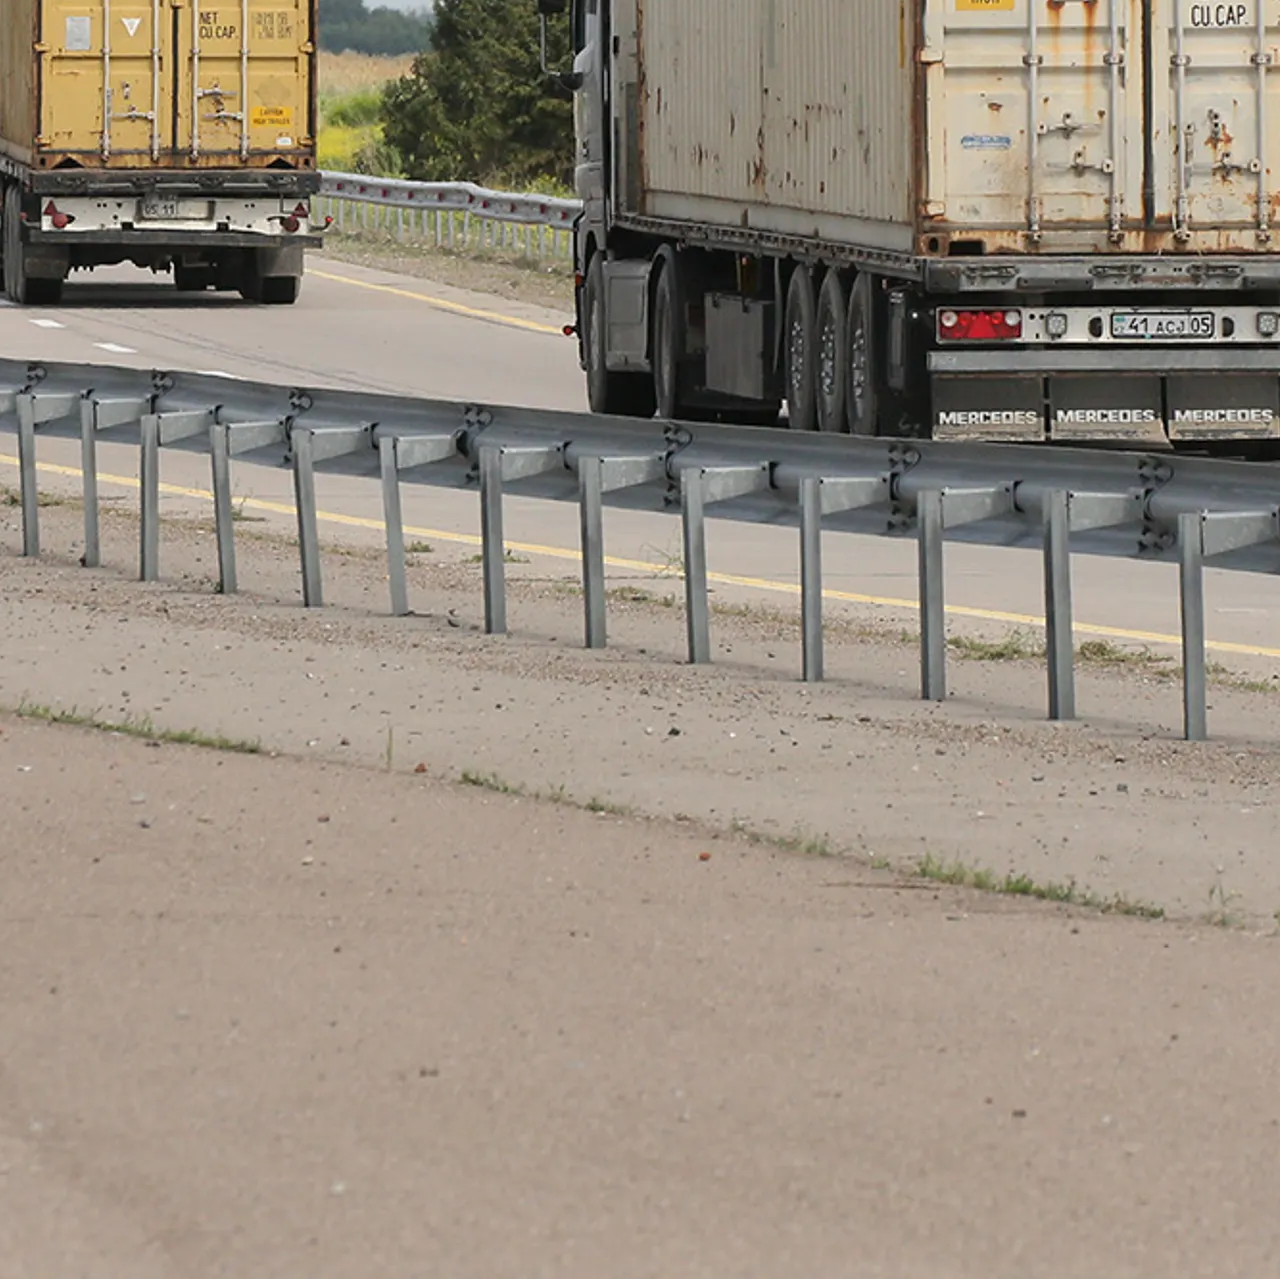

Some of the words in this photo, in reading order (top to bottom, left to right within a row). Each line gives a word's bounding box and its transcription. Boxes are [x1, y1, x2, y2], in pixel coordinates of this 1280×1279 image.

[200, 11, 218, 25] NET
[1129, 317, 1148, 333] 41
[1190, 317, 1210, 333] 05
[939, 410, 1037, 425] MERCEDES
[1057, 409, 1155, 423] MERCEDES
[1174, 408, 1273, 423] MERCEDES
